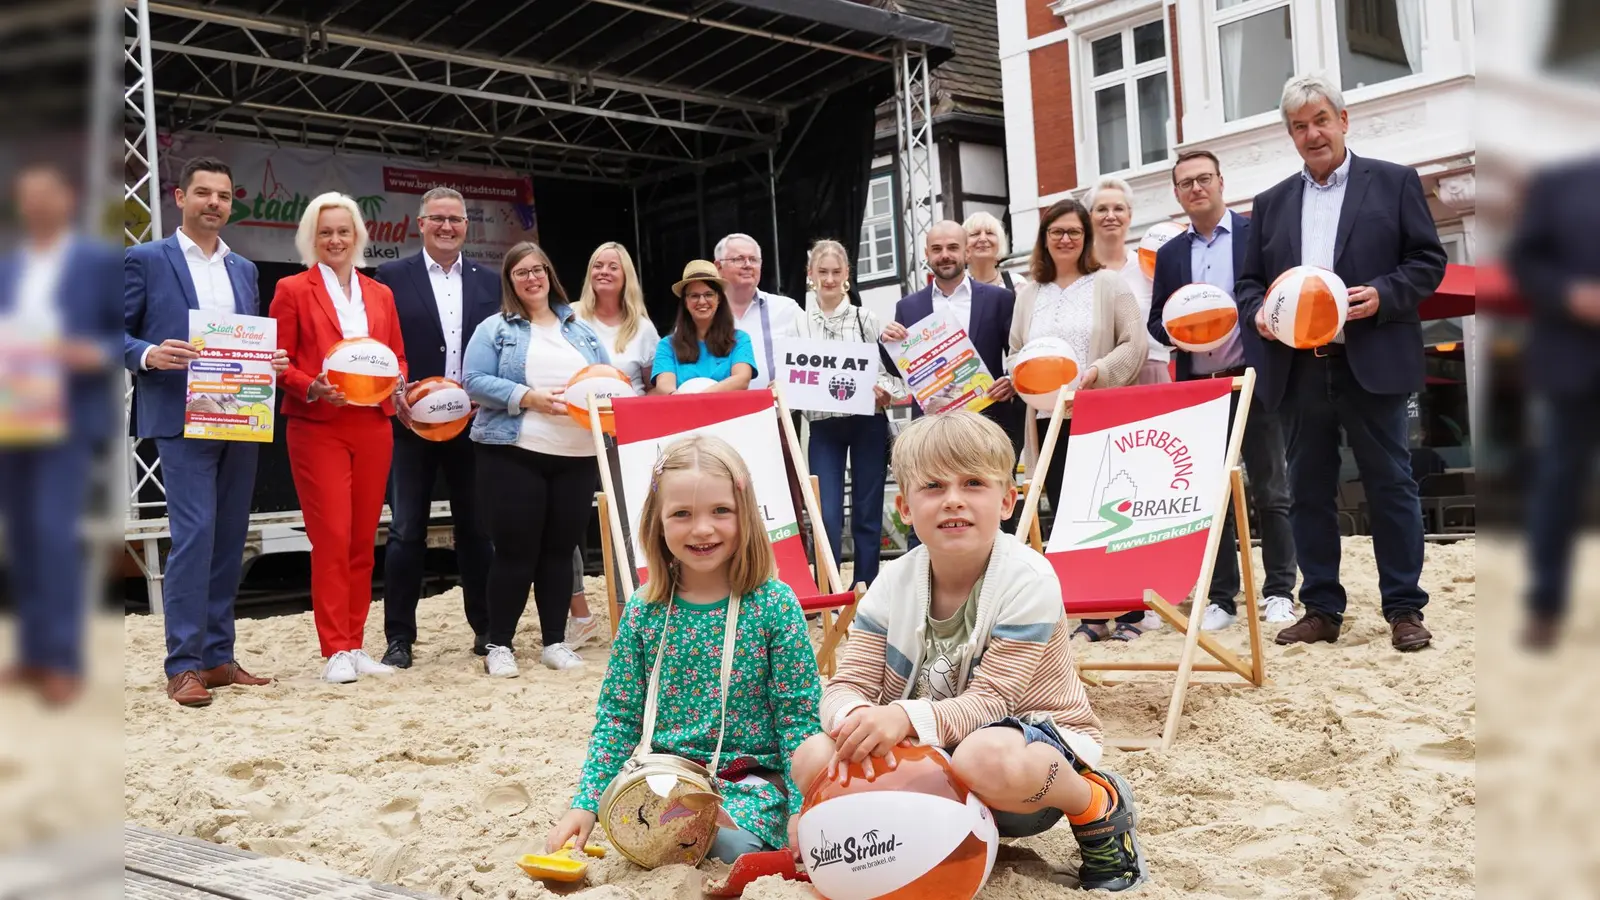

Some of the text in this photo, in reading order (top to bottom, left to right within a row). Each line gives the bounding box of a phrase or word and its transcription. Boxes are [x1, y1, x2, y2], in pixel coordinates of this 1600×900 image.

[366, 214, 420, 244] and-
[363, 244, 399, 259] akel
[785, 352, 869, 371] LOOK AT
[789, 369, 820, 385] ME
[1114, 429, 1193, 491] WERBERING
[1132, 496, 1201, 517] BRAKEL
[1112, 519, 1212, 551] www.brakel.de
[810, 842, 843, 872] Stadt
[851, 855, 897, 872] www.brakel.de
